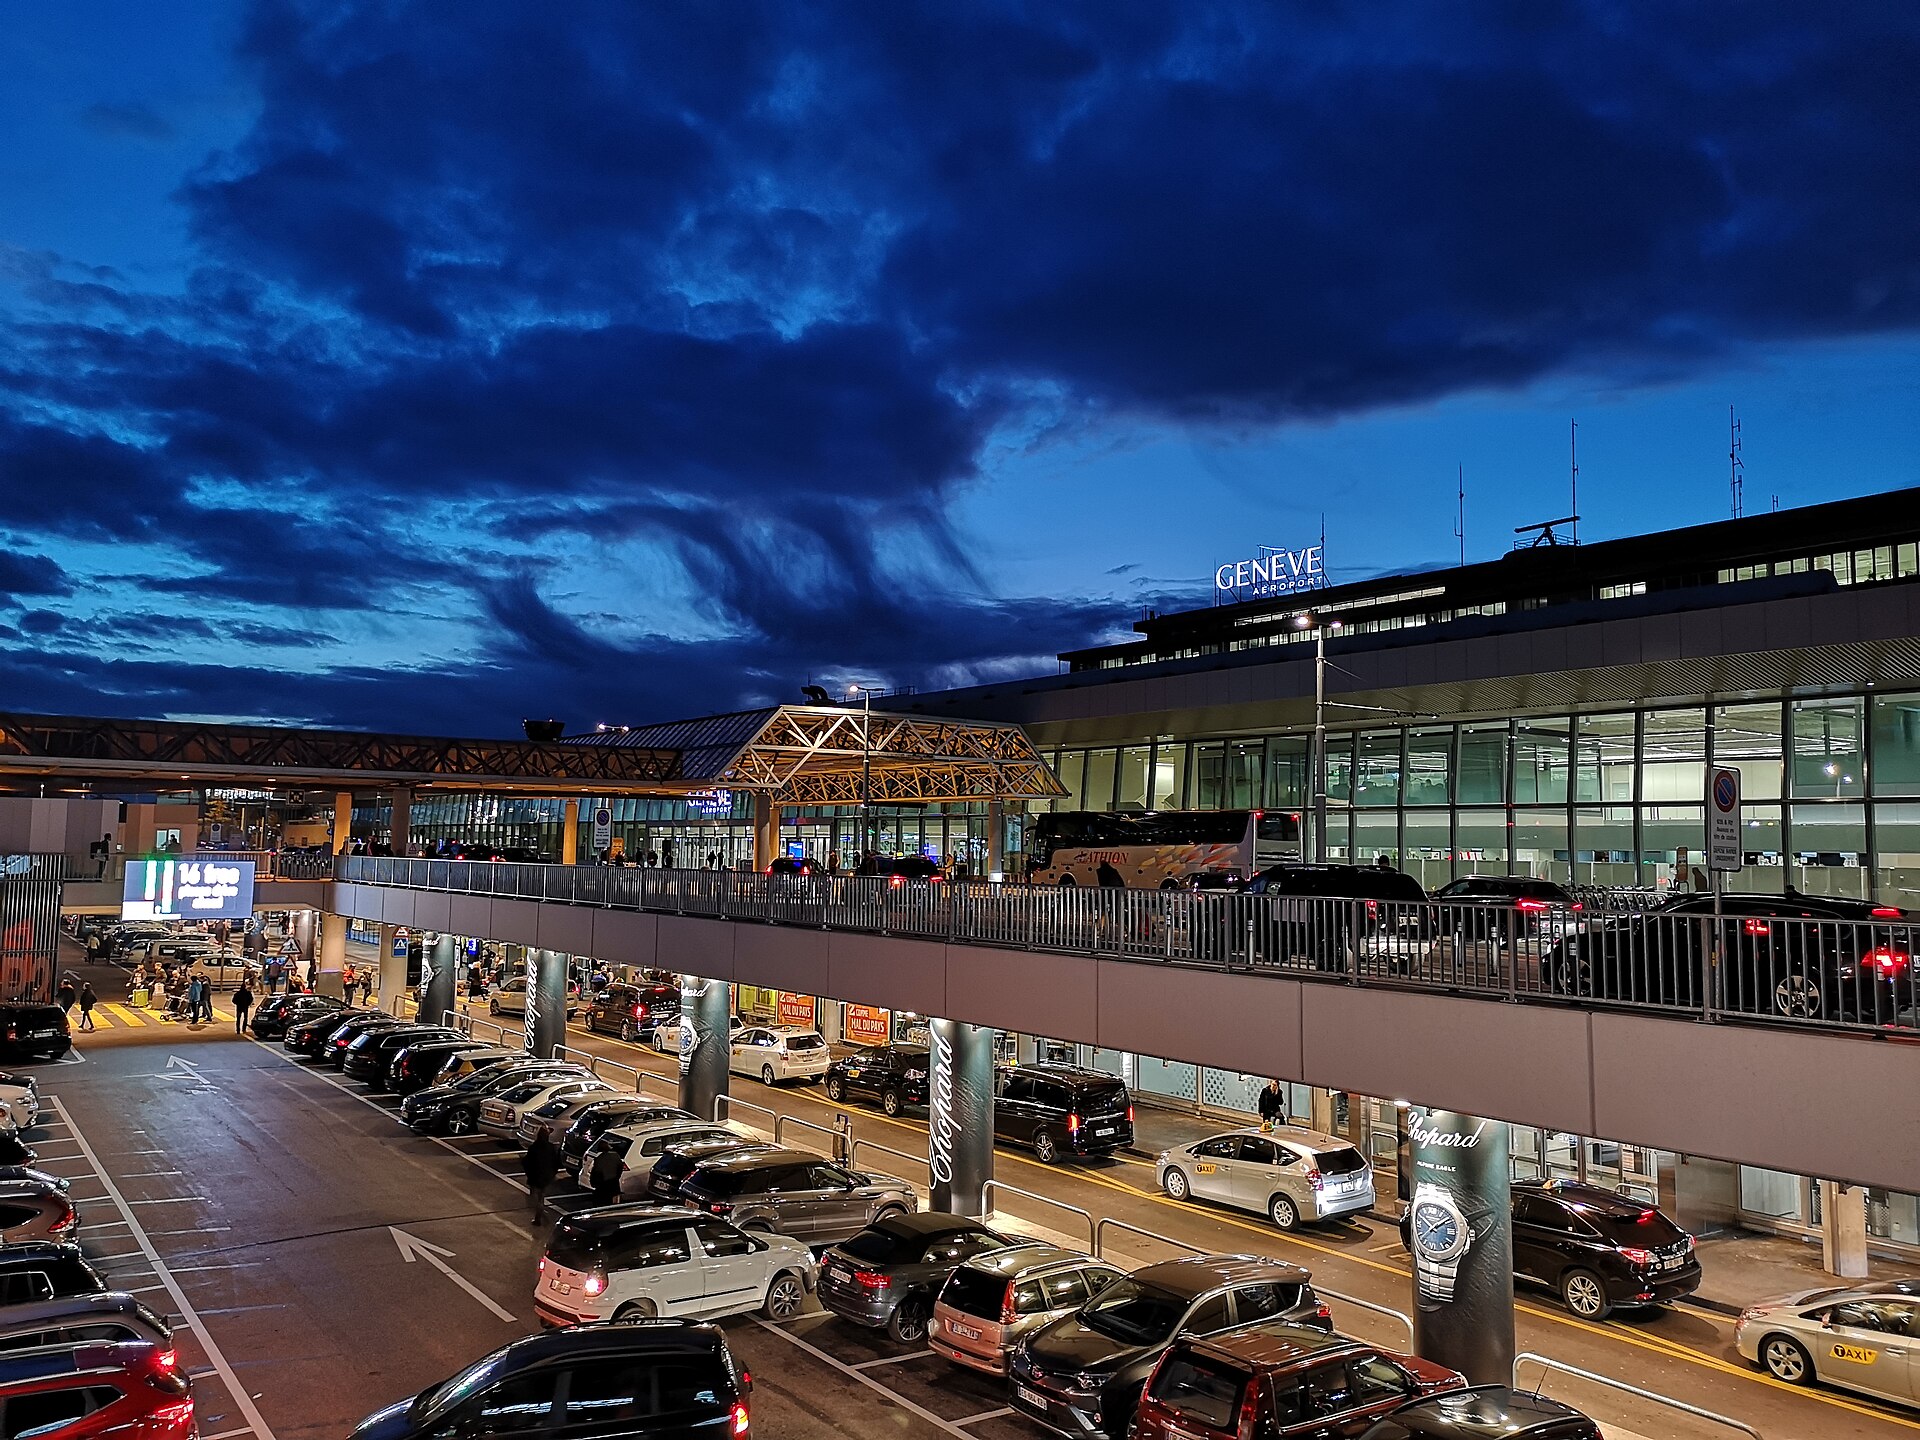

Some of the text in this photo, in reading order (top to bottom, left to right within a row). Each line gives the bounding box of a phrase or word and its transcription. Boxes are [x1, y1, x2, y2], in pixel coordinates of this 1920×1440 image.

[178, 862, 201, 885] 16
[799, 1007, 811, 1018] PAYS
[851, 1018, 885, 1033] MAL DU PAYS
[928, 1018, 963, 1191] Chopard
[1196, 1164, 1214, 1173] TAXI
[1833, 1344, 1868, 1362] TAXI
